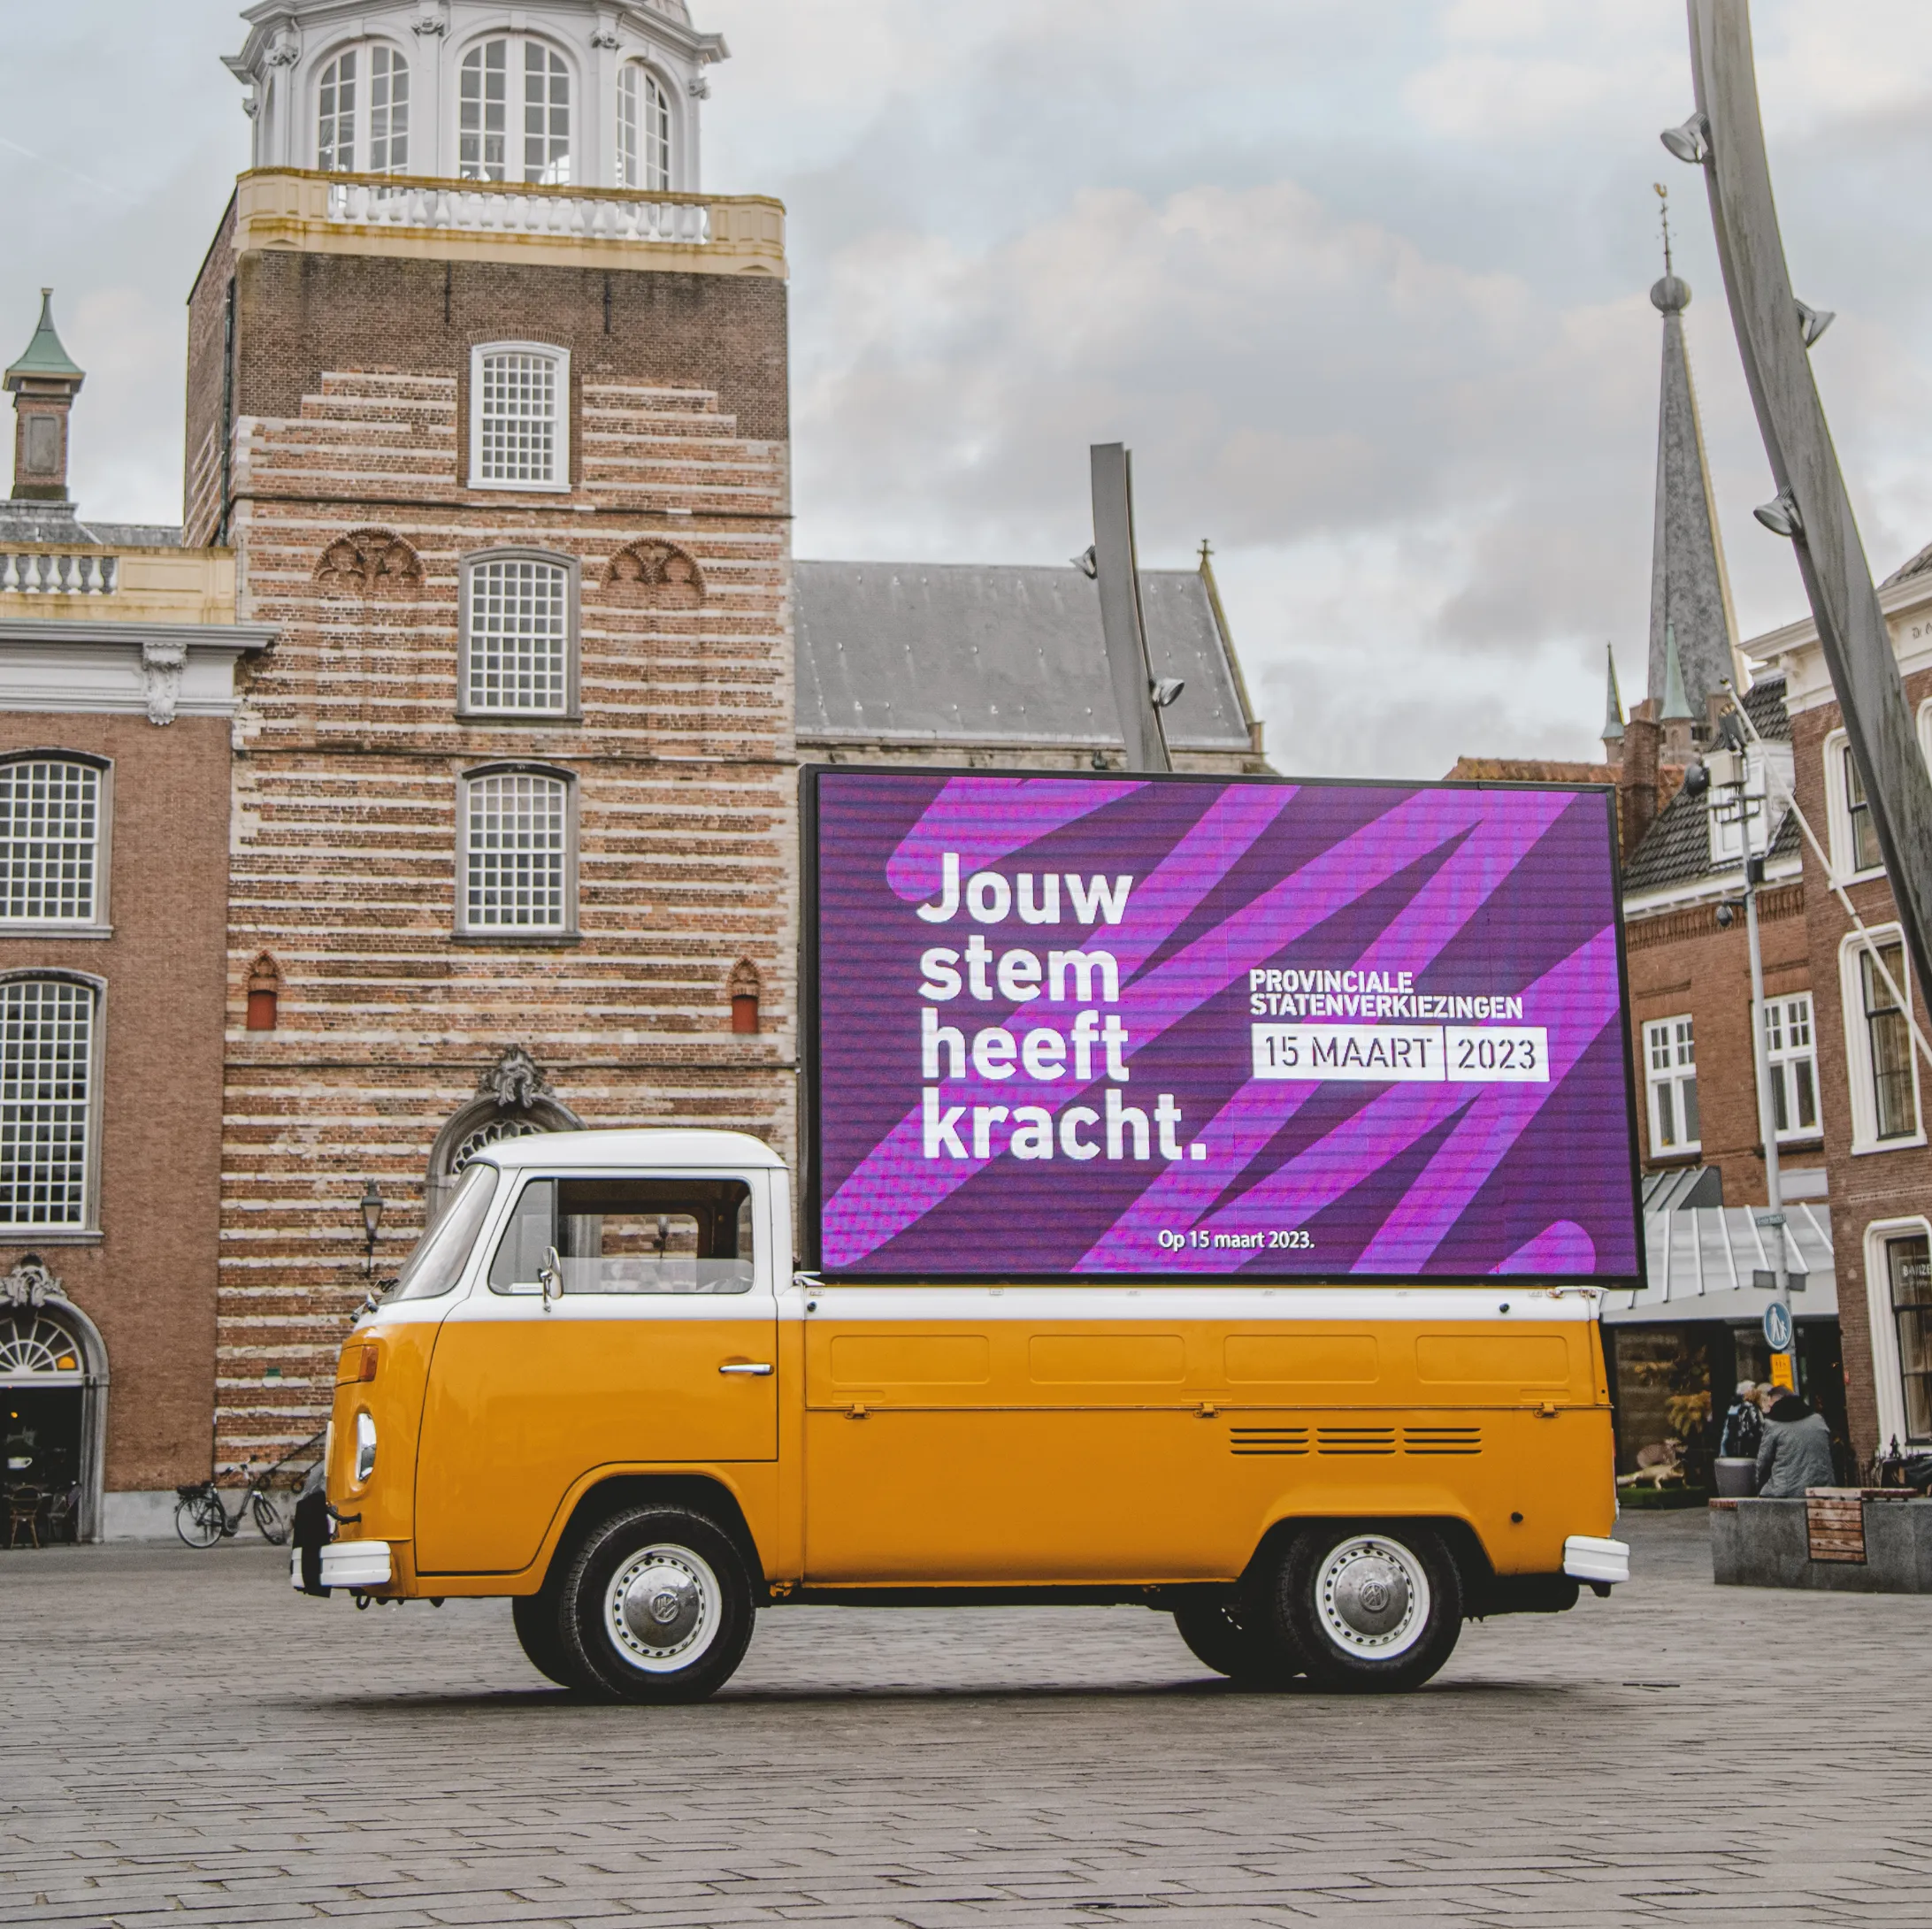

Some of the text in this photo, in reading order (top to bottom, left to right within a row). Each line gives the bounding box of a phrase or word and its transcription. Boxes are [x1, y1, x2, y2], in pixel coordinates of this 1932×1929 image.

[916, 853, 1133, 924] Jouw
[918, 935, 1120, 1002] stem
[1250, 969, 1414, 993] PROVINCIALE
[1250, 993, 1522, 1019] STATENVERKIEZINGEN
[922, 1007, 1130, 1081] heeft
[1266, 1036, 1536, 1069] 15 MAART 2023
[922, 1087, 1207, 1160] kracht.
[1158, 1229, 1315, 1252] Op 15 maart 2023.
